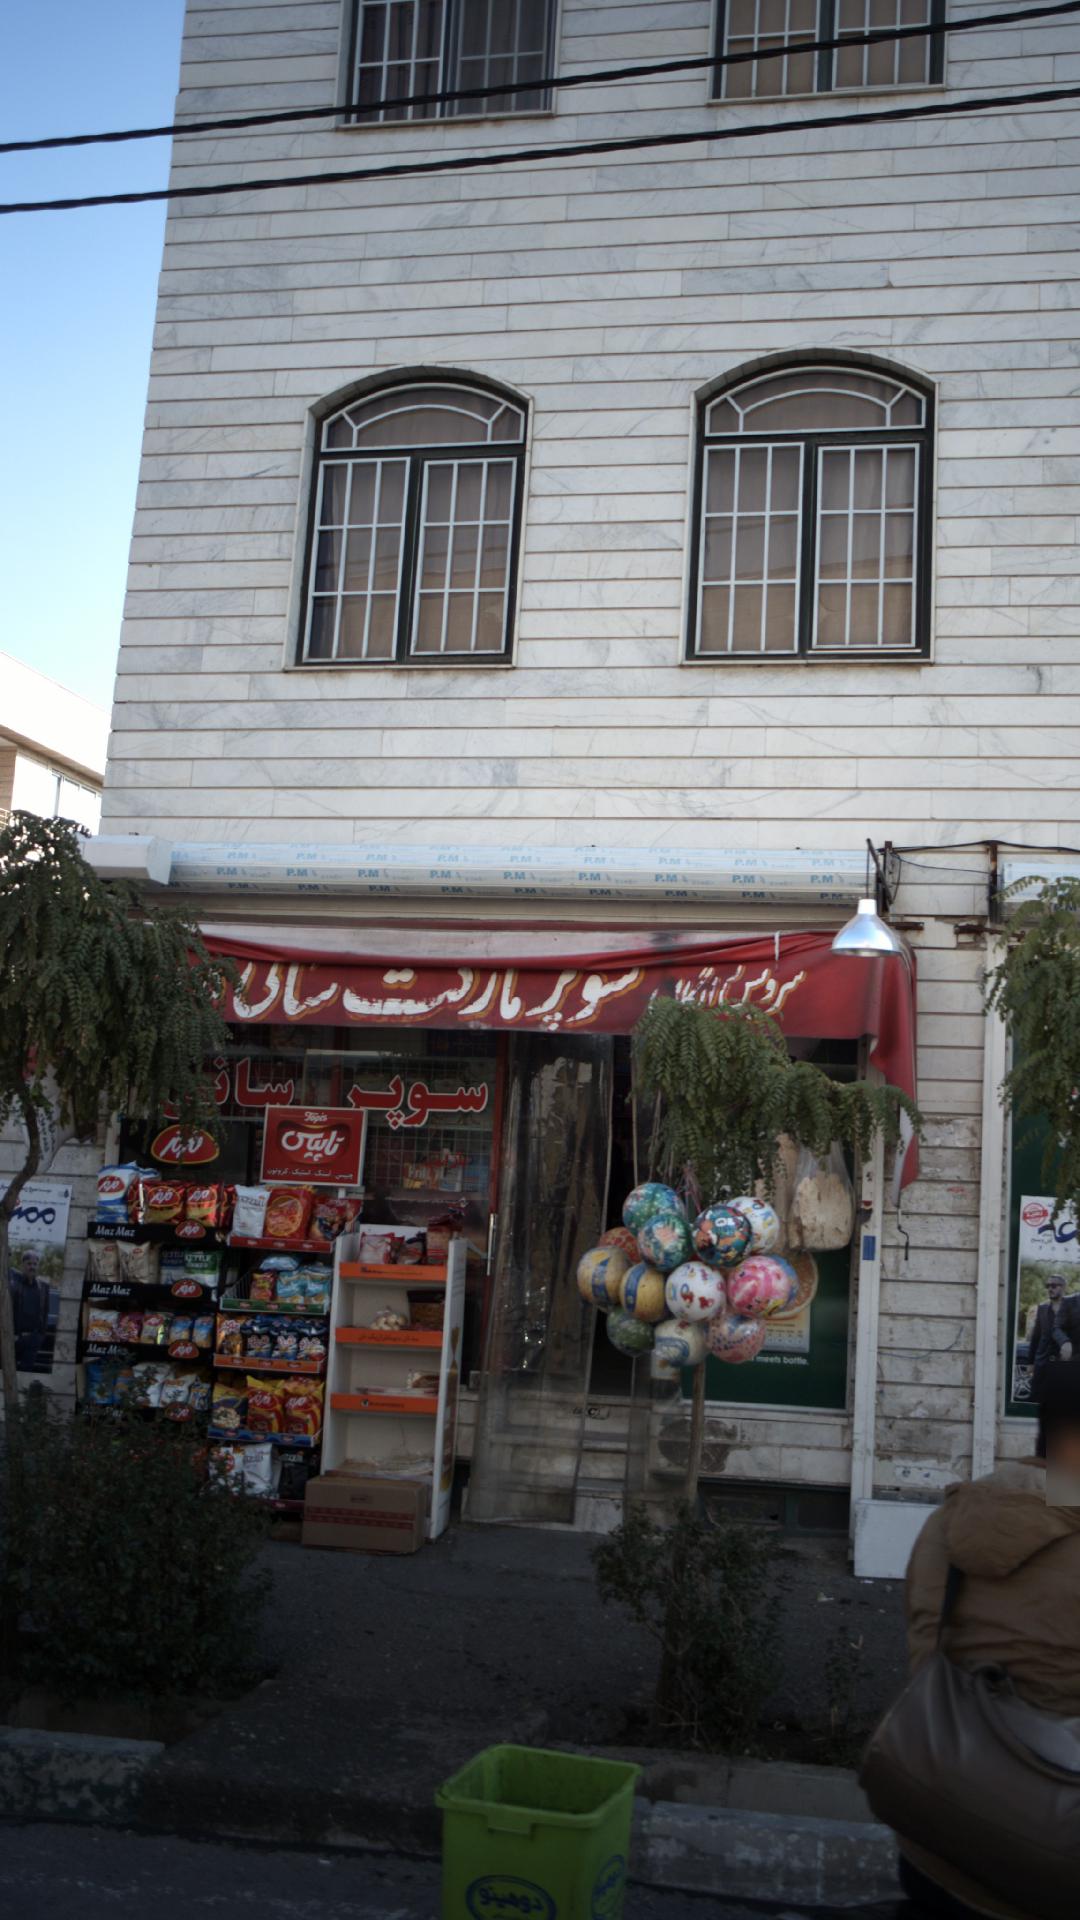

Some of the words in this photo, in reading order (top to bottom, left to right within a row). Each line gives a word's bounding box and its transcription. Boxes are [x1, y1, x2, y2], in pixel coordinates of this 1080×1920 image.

[217, 867, 237, 875] P.M
[287, 868, 308, 876] P.M
[358, 869, 379, 878] P.M
[430, 870, 451, 879] P.M
[503, 871, 526, 880] P.M
[578, 872, 601, 881] P.M
[655, 873, 678, 882] P.M
[732, 875, 755, 884] P.M
[810, 875, 834, 884] P.M
[347, 1074, 489, 1129] سوپر
[95, 1225, 116, 1237] Maz
[116, 1227, 135, 1237] Maz
[90, 1284, 110, 1294] Maz
[112, 1286, 131, 1296] Maz
[86, 1343, 107, 1354] Maz
